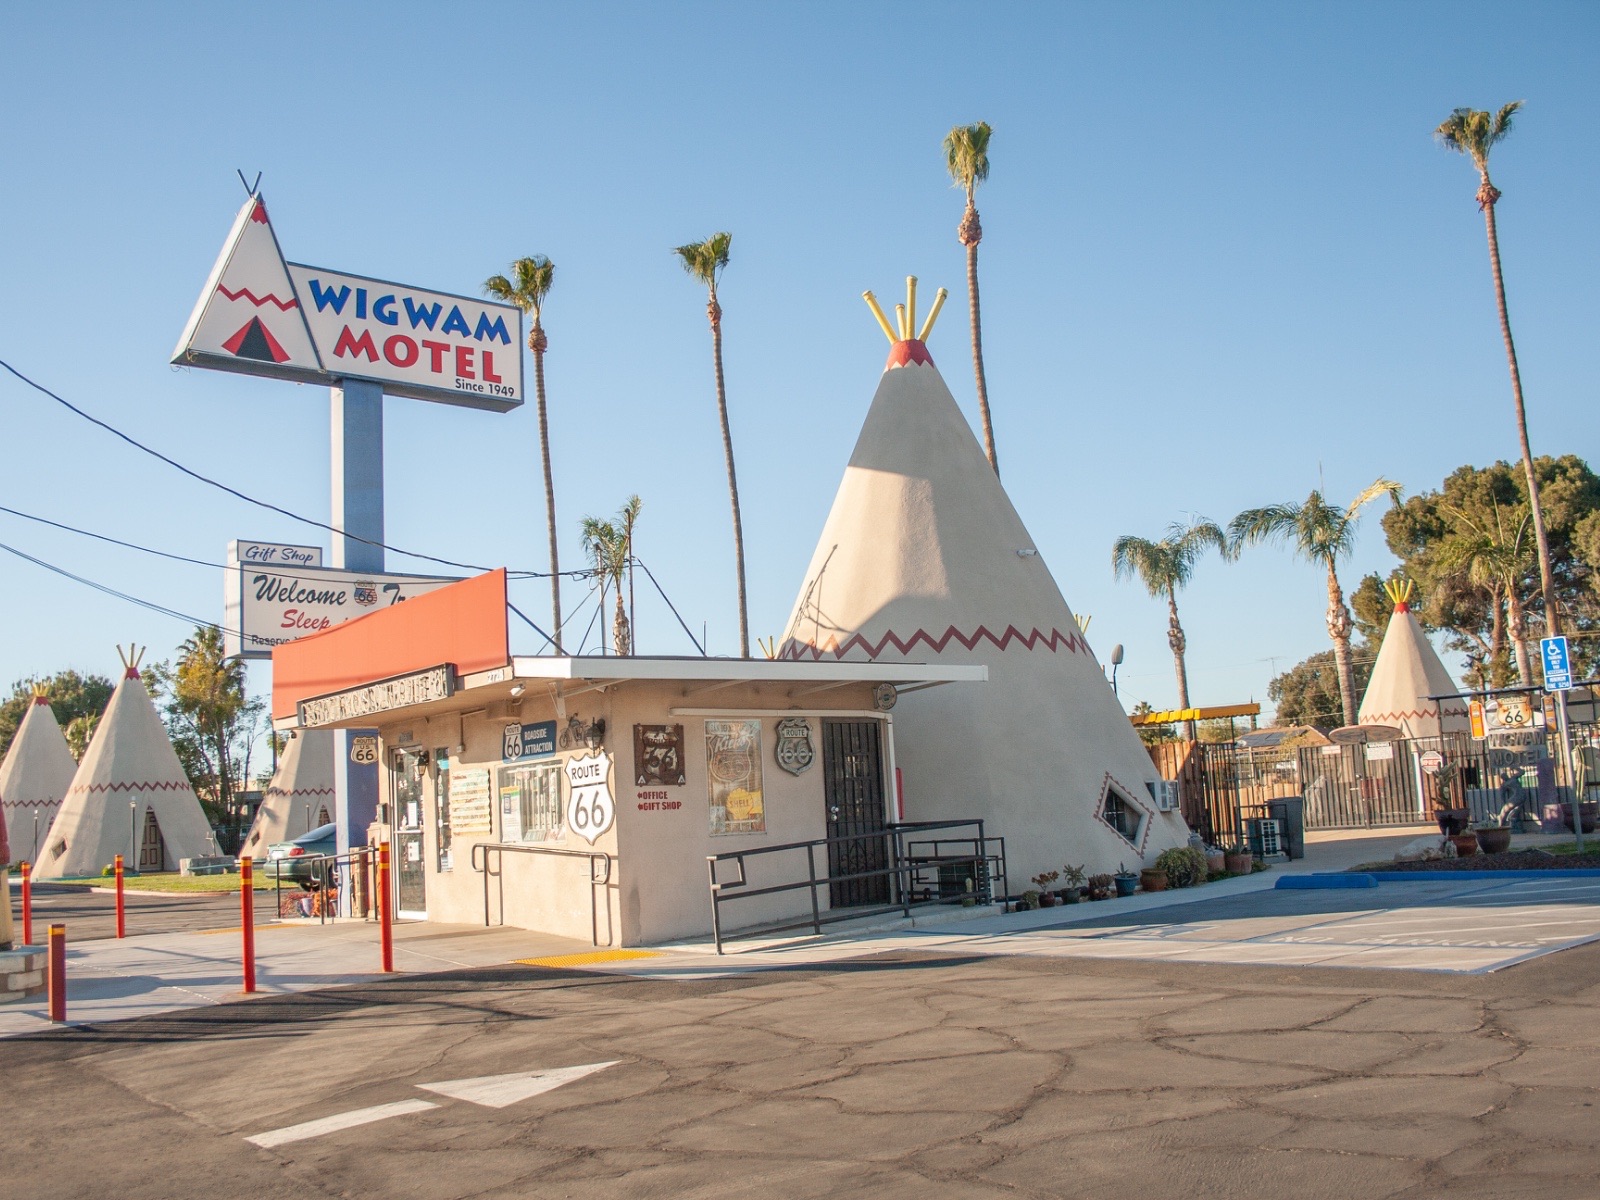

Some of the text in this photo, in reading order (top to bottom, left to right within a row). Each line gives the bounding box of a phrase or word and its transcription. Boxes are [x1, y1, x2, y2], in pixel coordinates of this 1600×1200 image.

[308, 279, 512, 346] WIGWAM
[332, 324, 502, 384] MOTEL
[455, 378, 515, 397] Since 1949
[245, 545, 314, 566] Gift Shop
[252, 574, 348, 606] Welcome
[358, 590, 374, 602] 66
[280, 608, 331, 631] Sleep
[1505, 711, 1523, 724] 66
[506, 726, 520, 734] ROUTE
[524, 728, 548, 741] ROADSIDE
[785, 729, 805, 737] ROUTE
[507, 736, 521, 757] 66
[524, 741, 553, 755] ATTRACTION
[782, 739, 811, 765] 66
[356, 749, 374, 761] 66
[571, 764, 600, 780] ROUTE
[642, 791, 668, 800] OFFICE
[574, 790, 605, 830] 66
[643, 801, 682, 811] GIFT SHOP
[729, 799, 750, 808] SHELL
[1268, 935, 1548, 948] NO PARKING
